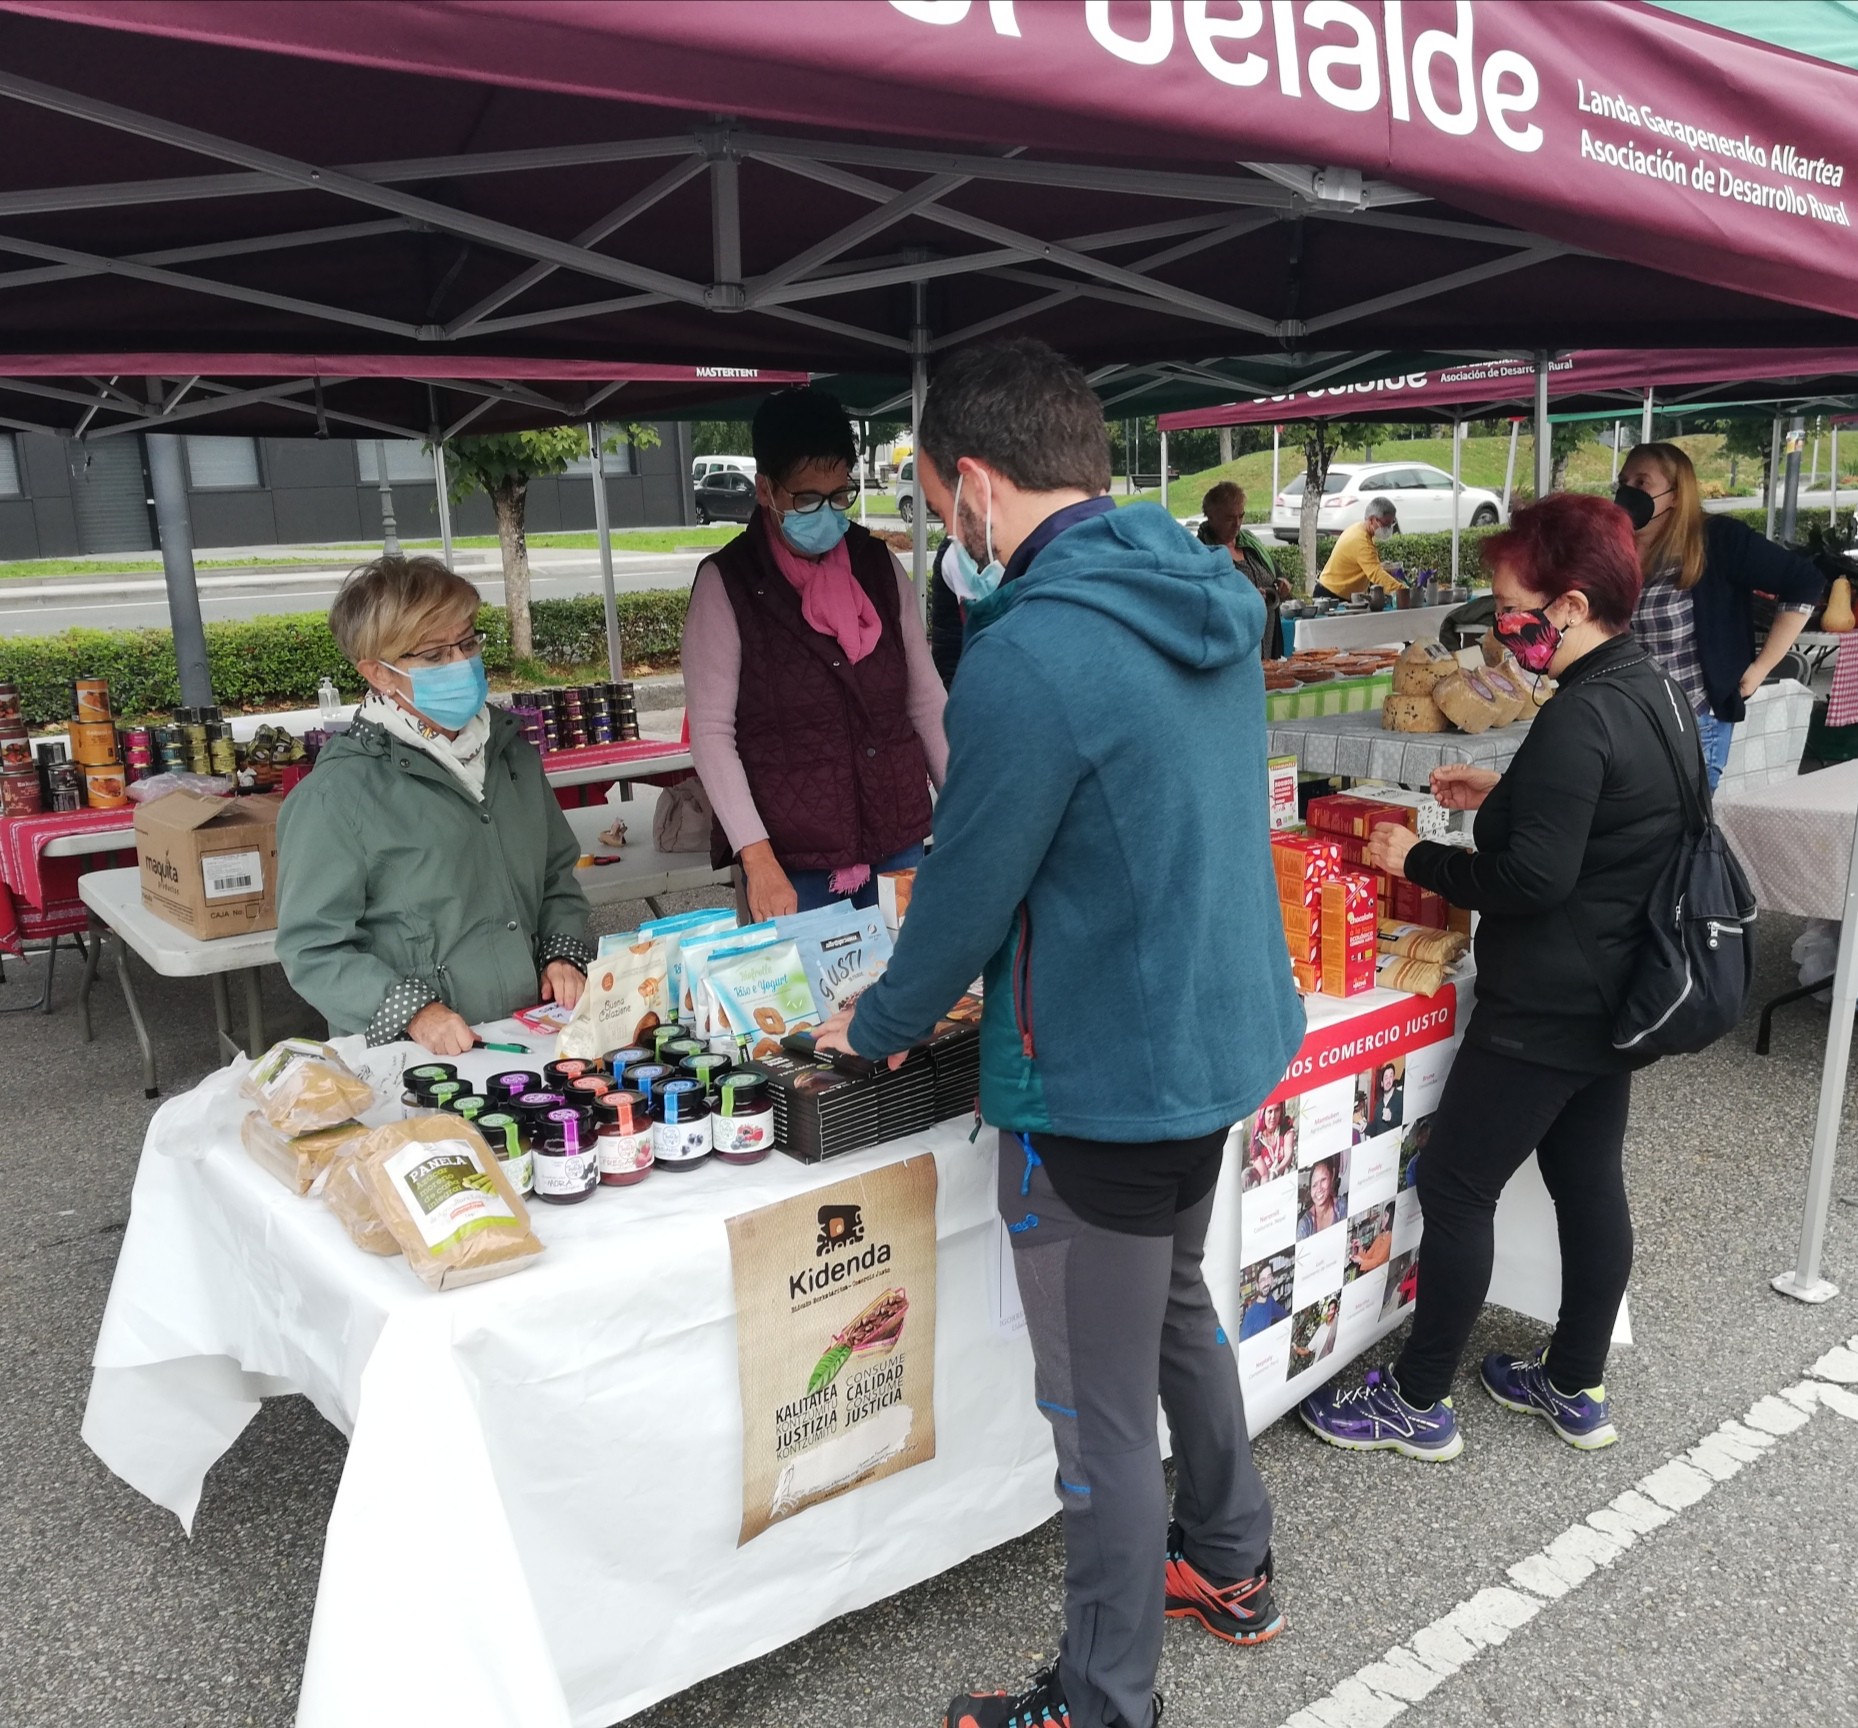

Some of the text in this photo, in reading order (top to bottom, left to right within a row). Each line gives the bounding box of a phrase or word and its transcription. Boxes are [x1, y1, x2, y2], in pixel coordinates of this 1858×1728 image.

[1577, 78, 1844, 188] Landa Garapenerako Alkartea
[1581, 128, 1851, 227] Asociación de Desarrollo Rural
[696, 367, 758, 377] MASTERTENT
[1440, 368, 1486, 382] Asociación
[1487, 367, 1499, 377] de
[1500, 364, 1535, 376] Desarro
[1548, 359, 1573, 371] Rural
[145, 855, 179, 883] maquita
[210, 911, 230, 919] CAJA
[752, 985, 757, 993] e
[758, 973, 788, 994] Yogurt
[599, 1005, 631, 1022] Colazione
[1281, 1007, 1448, 1082] IOS COMERCIO JUSTO
[409, 1156, 467, 1183] PANELA
[420, 1174, 454, 1197] moreno
[424, 1193, 436, 1204] de
[428, 1184, 462, 1210] integral
[789, 1243, 891, 1300] Kidenda
[845, 1353, 905, 1386] CONSUME
[846, 1364, 904, 1401] CALIDAD
[776, 1384, 838, 1424] KALITATEA
[845, 1376, 904, 1412] CONSUME
[845, 1388, 902, 1427] JUSTICIA
[776, 1398, 838, 1435] KONTZUMITU
[776, 1410, 838, 1451] JUSTIZIA
[776, 1423, 837, 1461] KONTZUMITU
